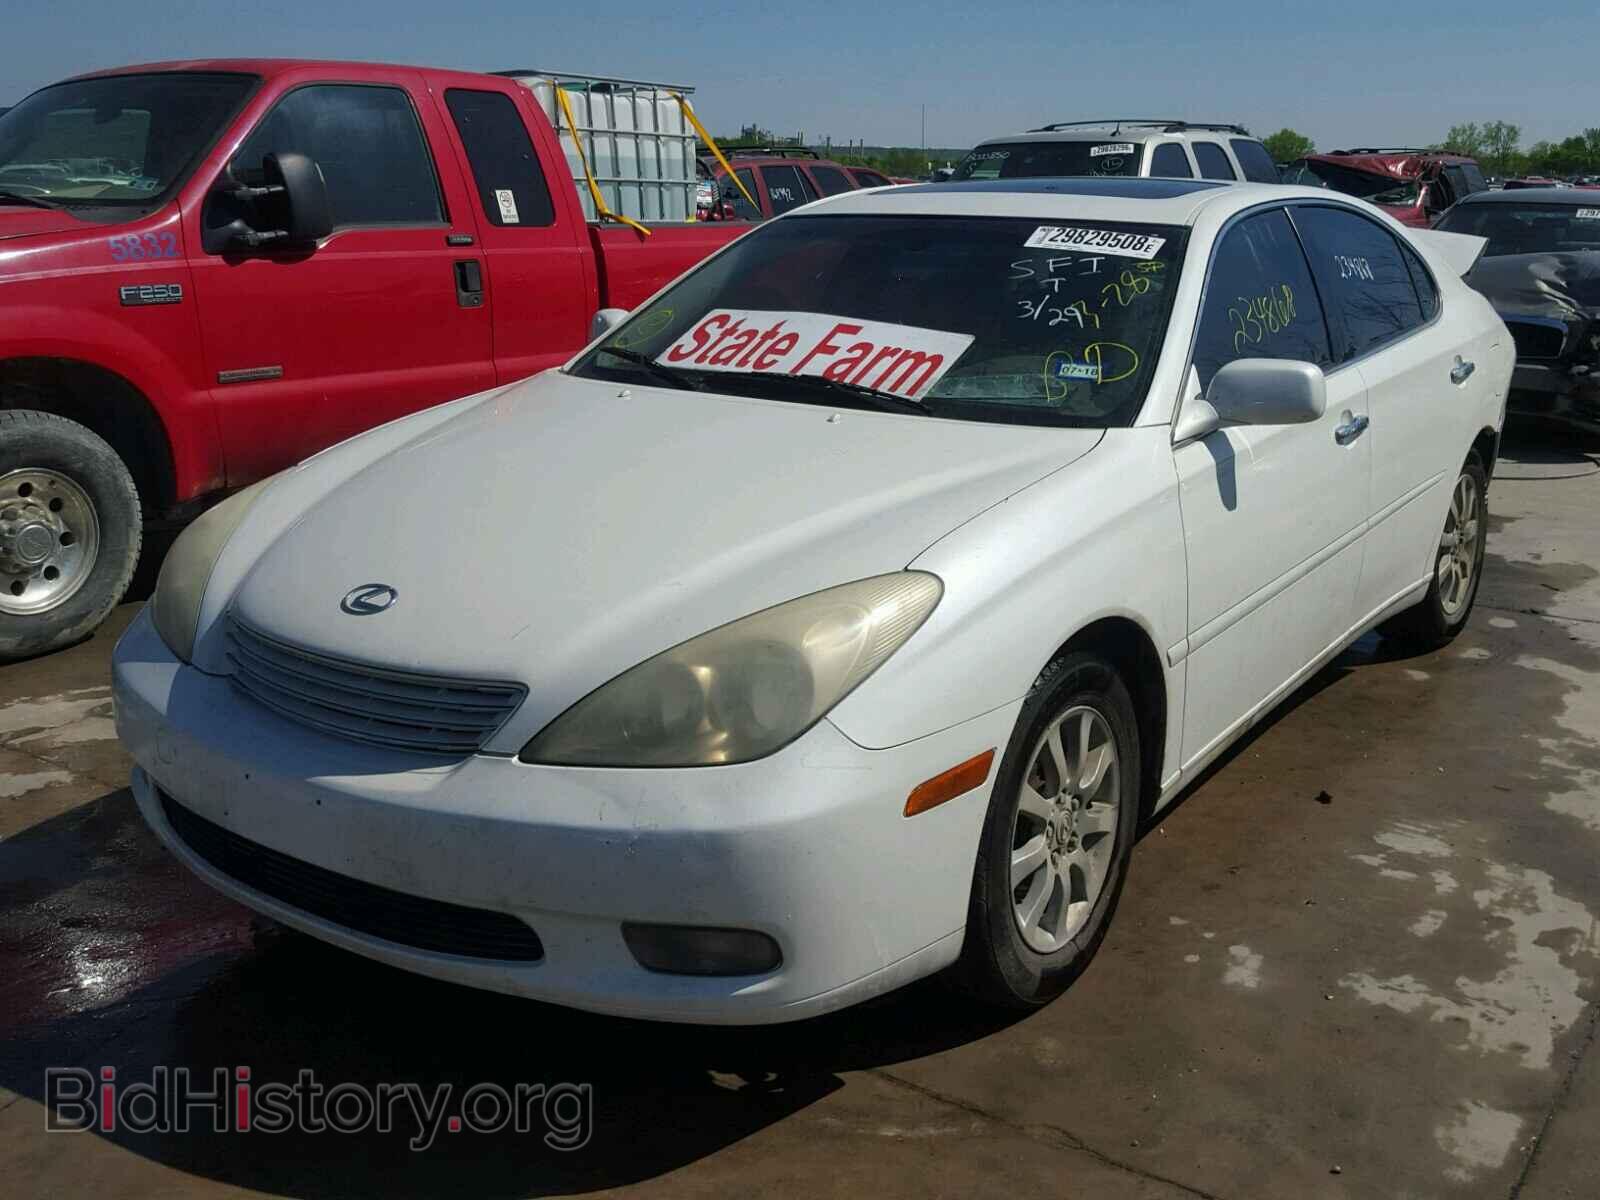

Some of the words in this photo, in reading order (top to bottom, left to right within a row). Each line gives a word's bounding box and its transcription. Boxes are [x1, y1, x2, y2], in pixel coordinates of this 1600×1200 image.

[108, 231, 181, 261] 5832
[1048, 228, 1149, 252] 29829508
[667, 313, 800, 371] State
[789, 322, 944, 397] Farm
